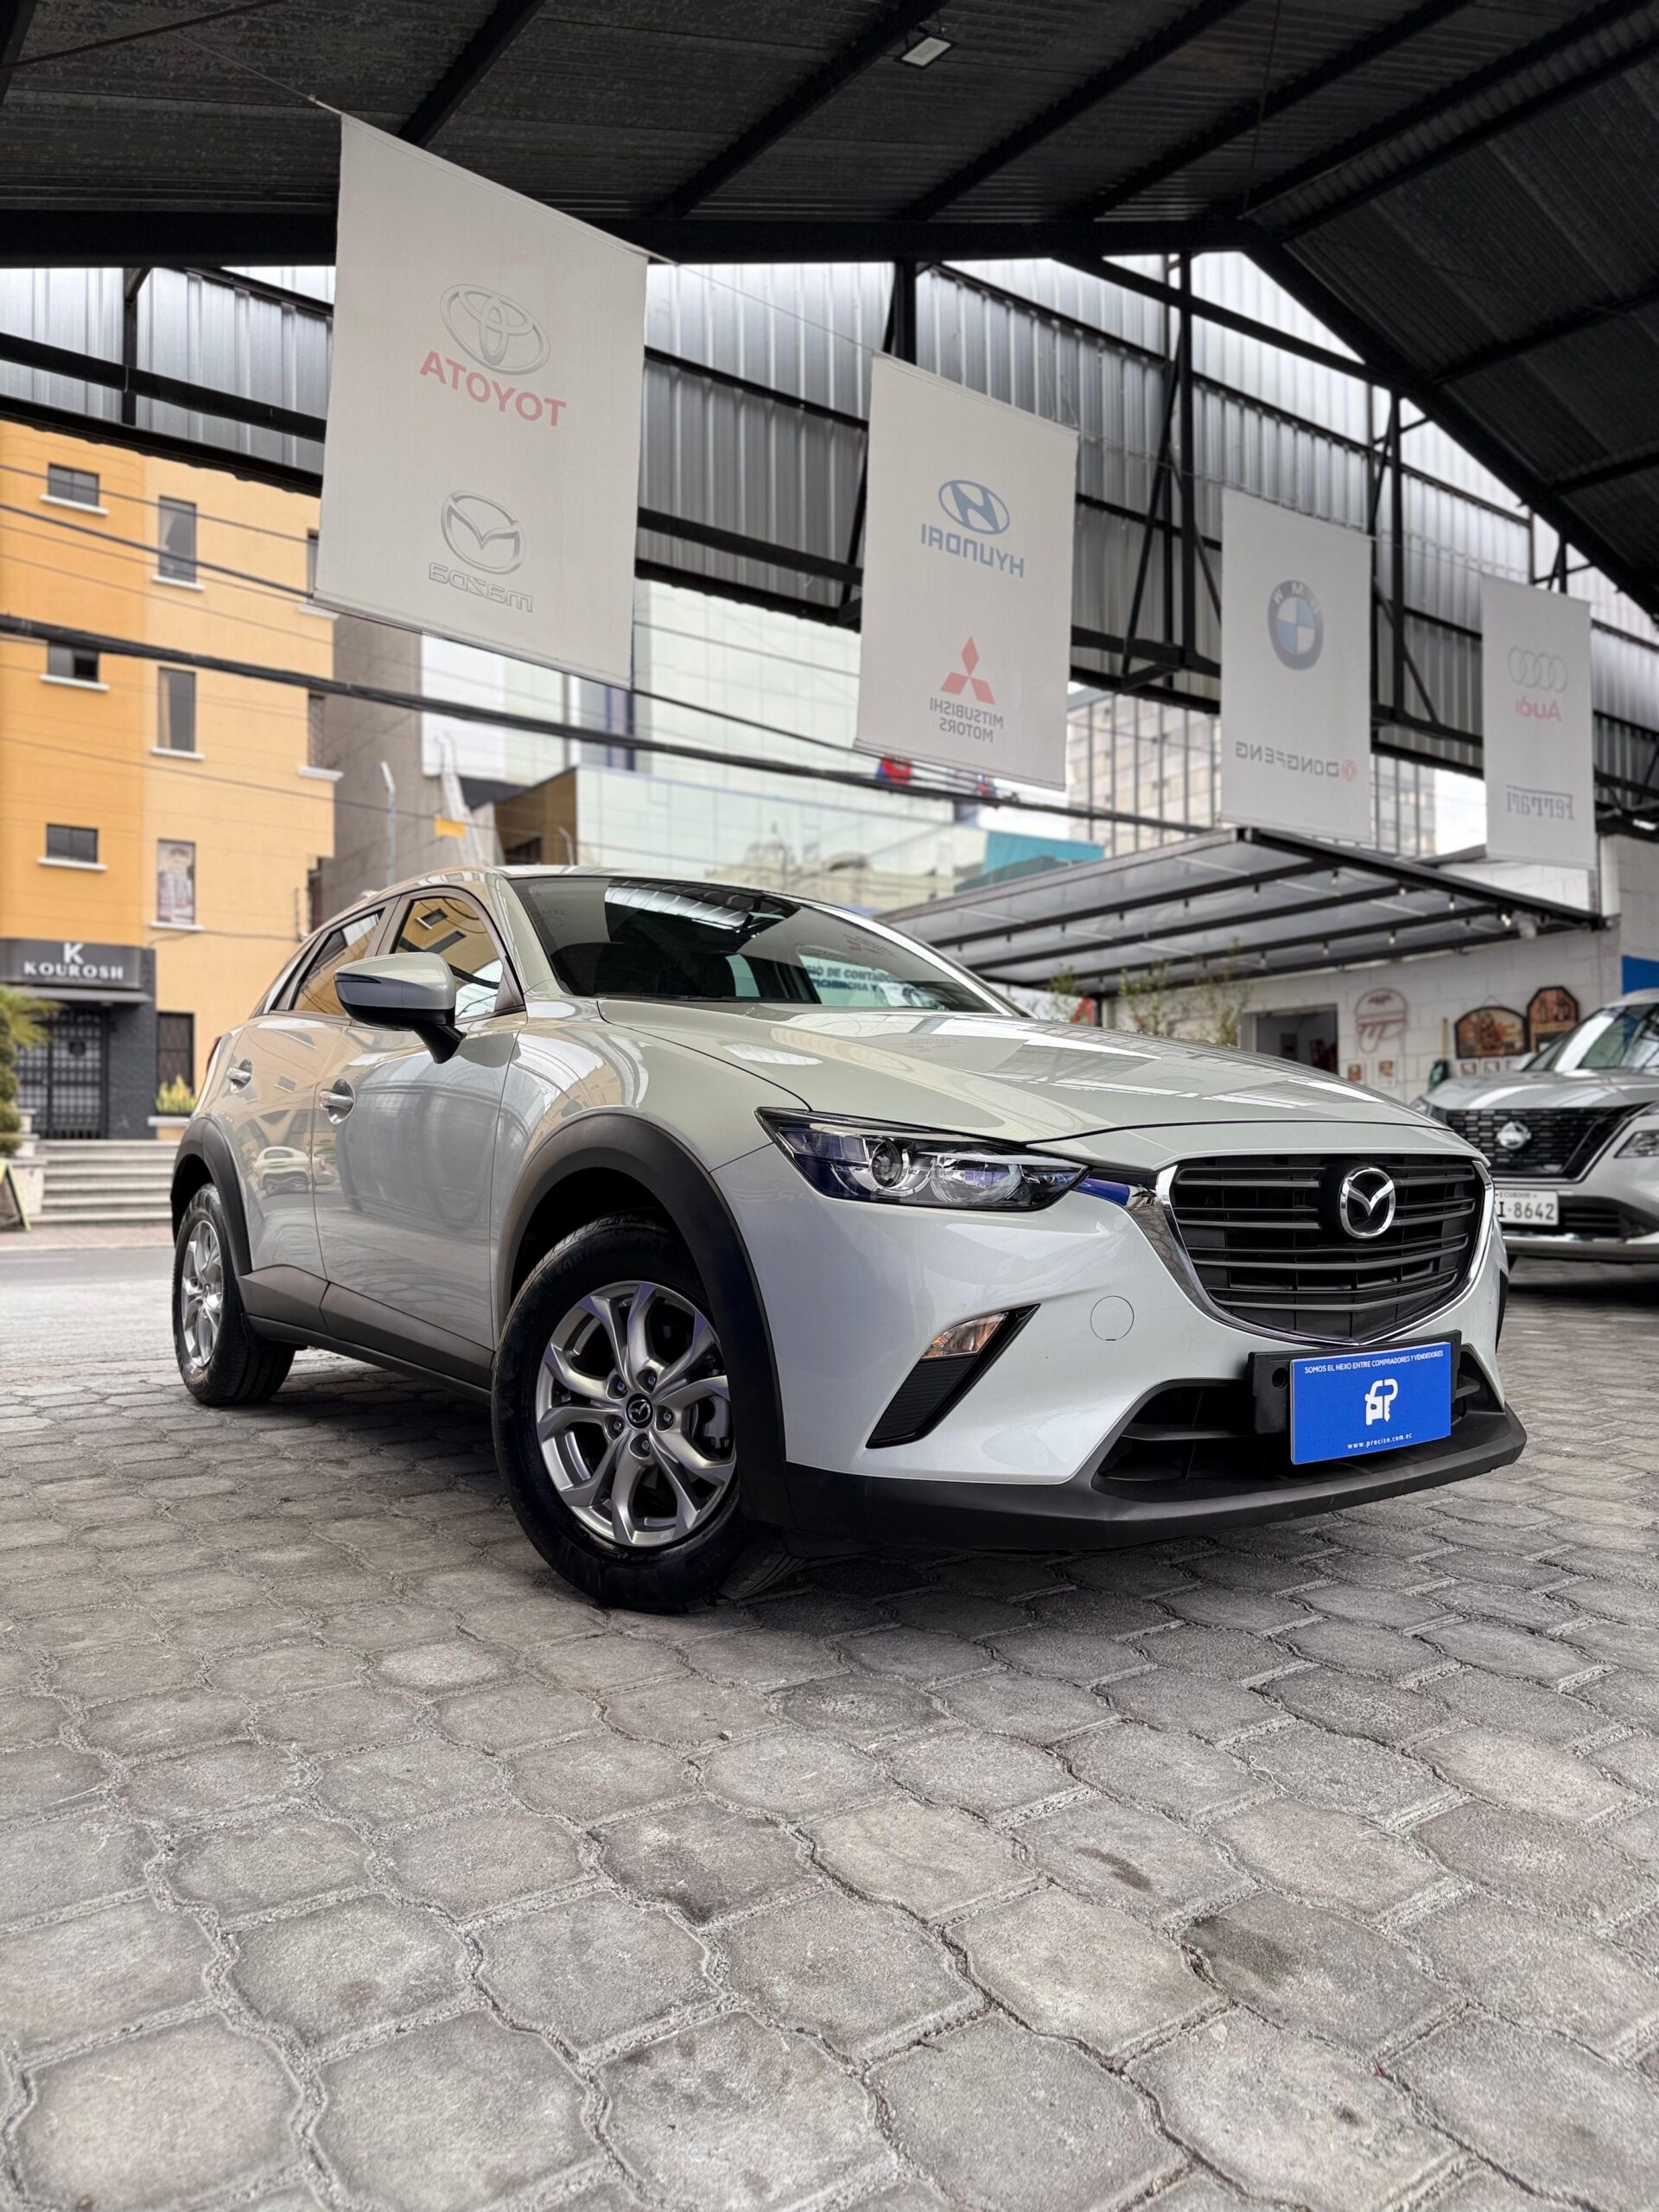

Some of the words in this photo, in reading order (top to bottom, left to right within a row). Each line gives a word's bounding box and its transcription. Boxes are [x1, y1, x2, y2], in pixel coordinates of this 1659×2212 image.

[63, 943, 85, 964] K
[23, 961, 124, 980] KOUROSH
[1494, 1200, 1554, 1220] I-8642
[1304, 1365, 1327, 1375] SOMOS
[1352, 1360, 1371, 1370] ENTRE
[1371, 1355, 1411, 1368] COMPRADORES
[1414, 1350, 1444, 1361] VENDEDORES
[1347, 1433, 1413, 1449] www.preciso.com.ec
